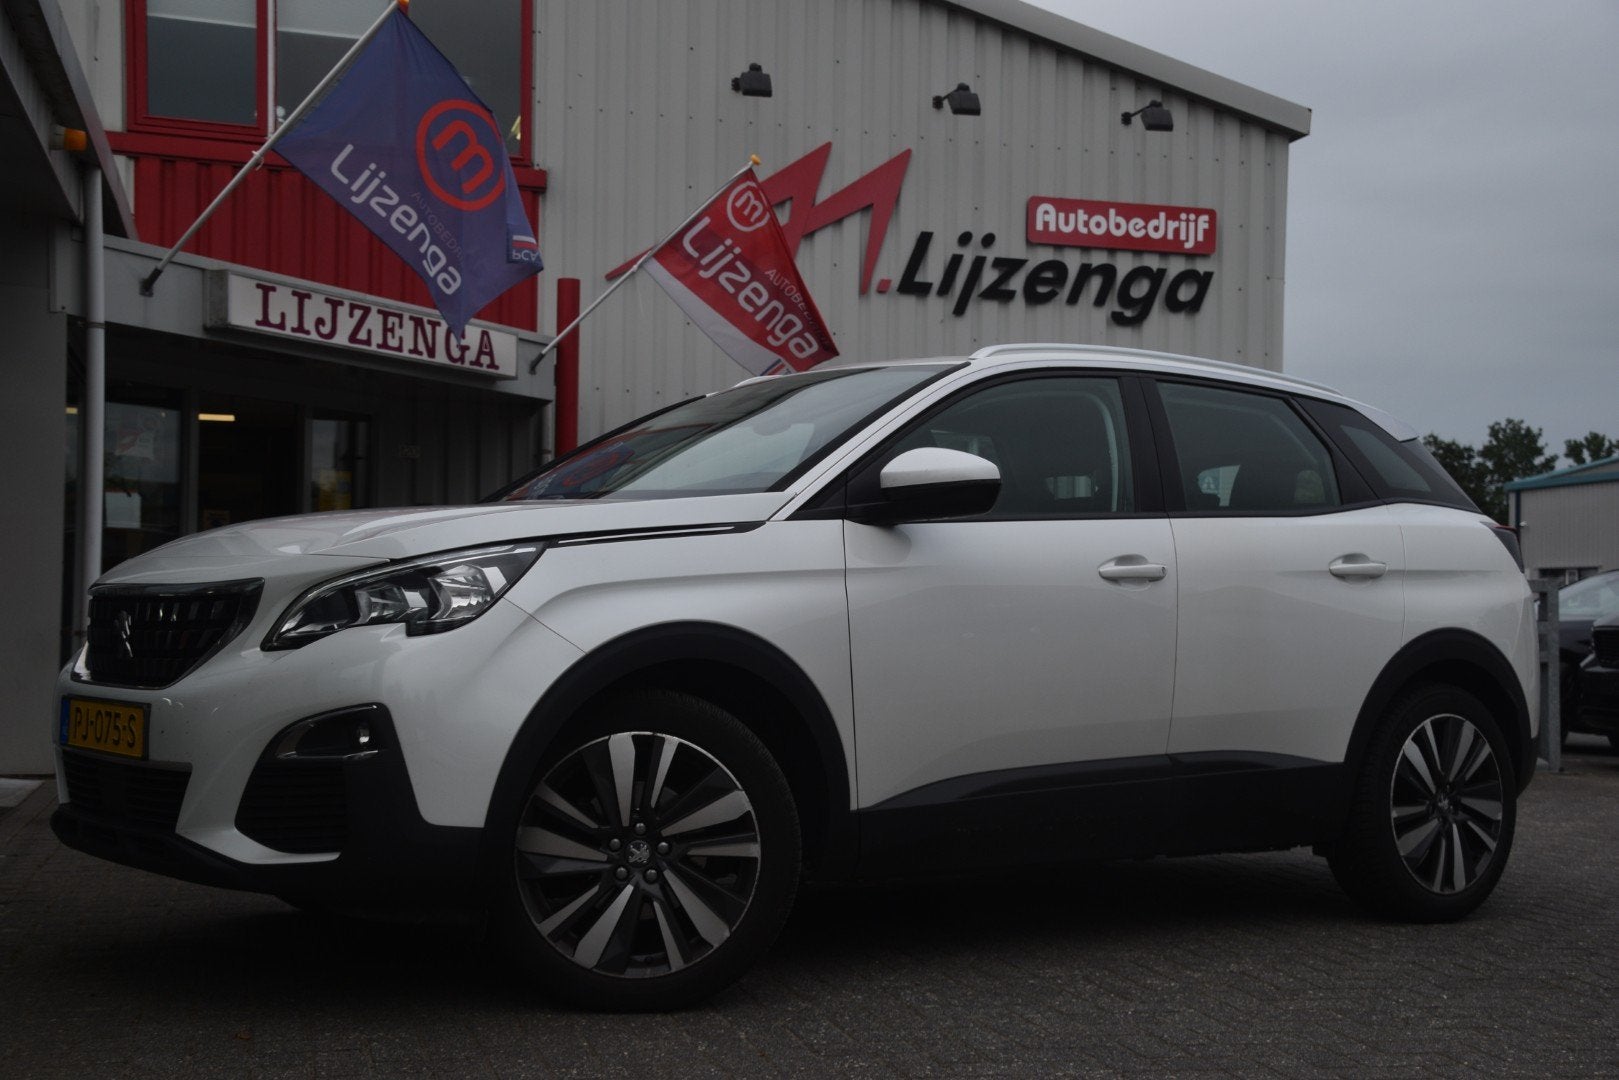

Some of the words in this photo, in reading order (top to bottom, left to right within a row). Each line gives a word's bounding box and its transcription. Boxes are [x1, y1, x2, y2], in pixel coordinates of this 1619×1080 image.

[330, 143, 461, 295] Lijzenga
[411, 191, 464, 265] AUTOBEDR
[1035, 203, 1209, 249] Autobedrijf
[682, 216, 819, 359] Lijzenga
[897, 231, 1214, 326] Lijzenga
[256, 283, 499, 370] LIJZENGA
[74, 706, 136, 748] PJ-075-S
